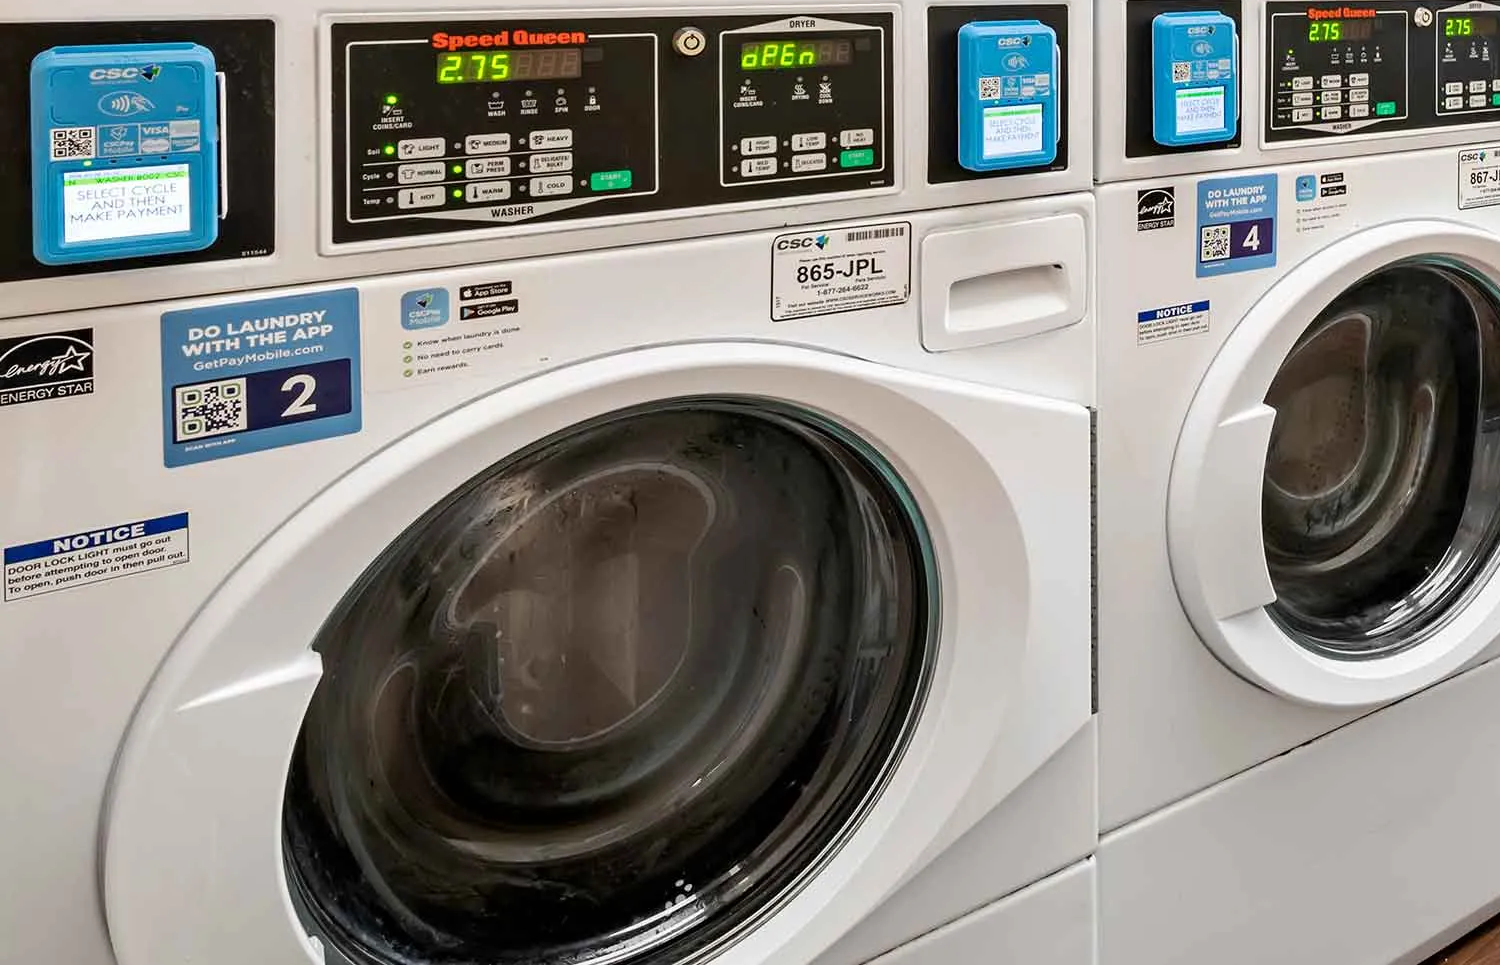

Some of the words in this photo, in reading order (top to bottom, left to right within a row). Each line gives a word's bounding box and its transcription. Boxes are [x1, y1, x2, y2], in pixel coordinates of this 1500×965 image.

[1308, 8, 1342, 20] Speed
[1343, 8, 1376, 18] Queen
[789, 20, 816, 28] DRYER
[1309, 23, 1340, 41] 2.75
[1446, 19, 1471, 35] 2.75
[432, 31, 509, 50] Speed
[513, 29, 585, 45] Queen
[88, 66, 137, 81] CSC
[439, 54, 509, 81] 2.75
[143, 126, 168, 135] VISA
[373, 122, 413, 130] COINS/CARD
[1461, 153, 1478, 162] CSC
[77, 187, 126, 201] SELECT
[131, 183, 177, 195] CYCLE
[1208, 190, 1221, 198] DO
[1223, 185, 1264, 197] LAUNDRY
[91, 199, 124, 211] AND
[130, 195, 165, 207] THEN
[1205, 199, 1229, 208] WITH
[1231, 197, 1248, 206] THE
[1249, 195, 1267, 204] APP
[70, 211, 112, 224] MAKE
[118, 204, 183, 218] PAYMENT
[491, 206, 534, 217] WASHER
[777, 237, 813, 251] CSC
[1242, 225, 1260, 250] 4
[797, 258, 883, 283] 865-JPL
[490, 287, 508, 295] Store
[477, 307, 500, 316] Google
[502, 305, 515, 313] Play
[1156, 305, 1192, 318] NOTICE
[188, 325, 221, 341] DO
[227, 310, 327, 335] LAUNDRY
[181, 338, 240, 357] WITH
[246, 331, 287, 348] THE
[292, 324, 333, 341] APP
[464, 331, 491, 339] laundry
[193, 344, 324, 371] GetPayMobile.com
[462, 346, 481, 354] carry
[0, 389, 54, 405] ENERGY
[57, 382, 93, 396] STAR
[280, 374, 316, 418] 2
[53, 523, 145, 554] NOTICE
[8, 562, 41, 575] DOOR
[45, 555, 75, 568] LOCK
[78, 548, 110, 561] LIGHT
[112, 543, 138, 554] must
[140, 540, 153, 549] go
[155, 536, 171, 545] out
[8, 573, 41, 585] before
[44, 562, 100, 577] attempting
[102, 556, 112, 564] to
[115, 553, 140, 563] open
[142, 547, 167, 557] door.
[8, 586, 21, 594] To
[56, 573, 82, 586] push
[84, 568, 108, 577] door
[122, 560, 145, 570] then
[147, 555, 165, 566] pull
[167, 551, 185, 561] out.
